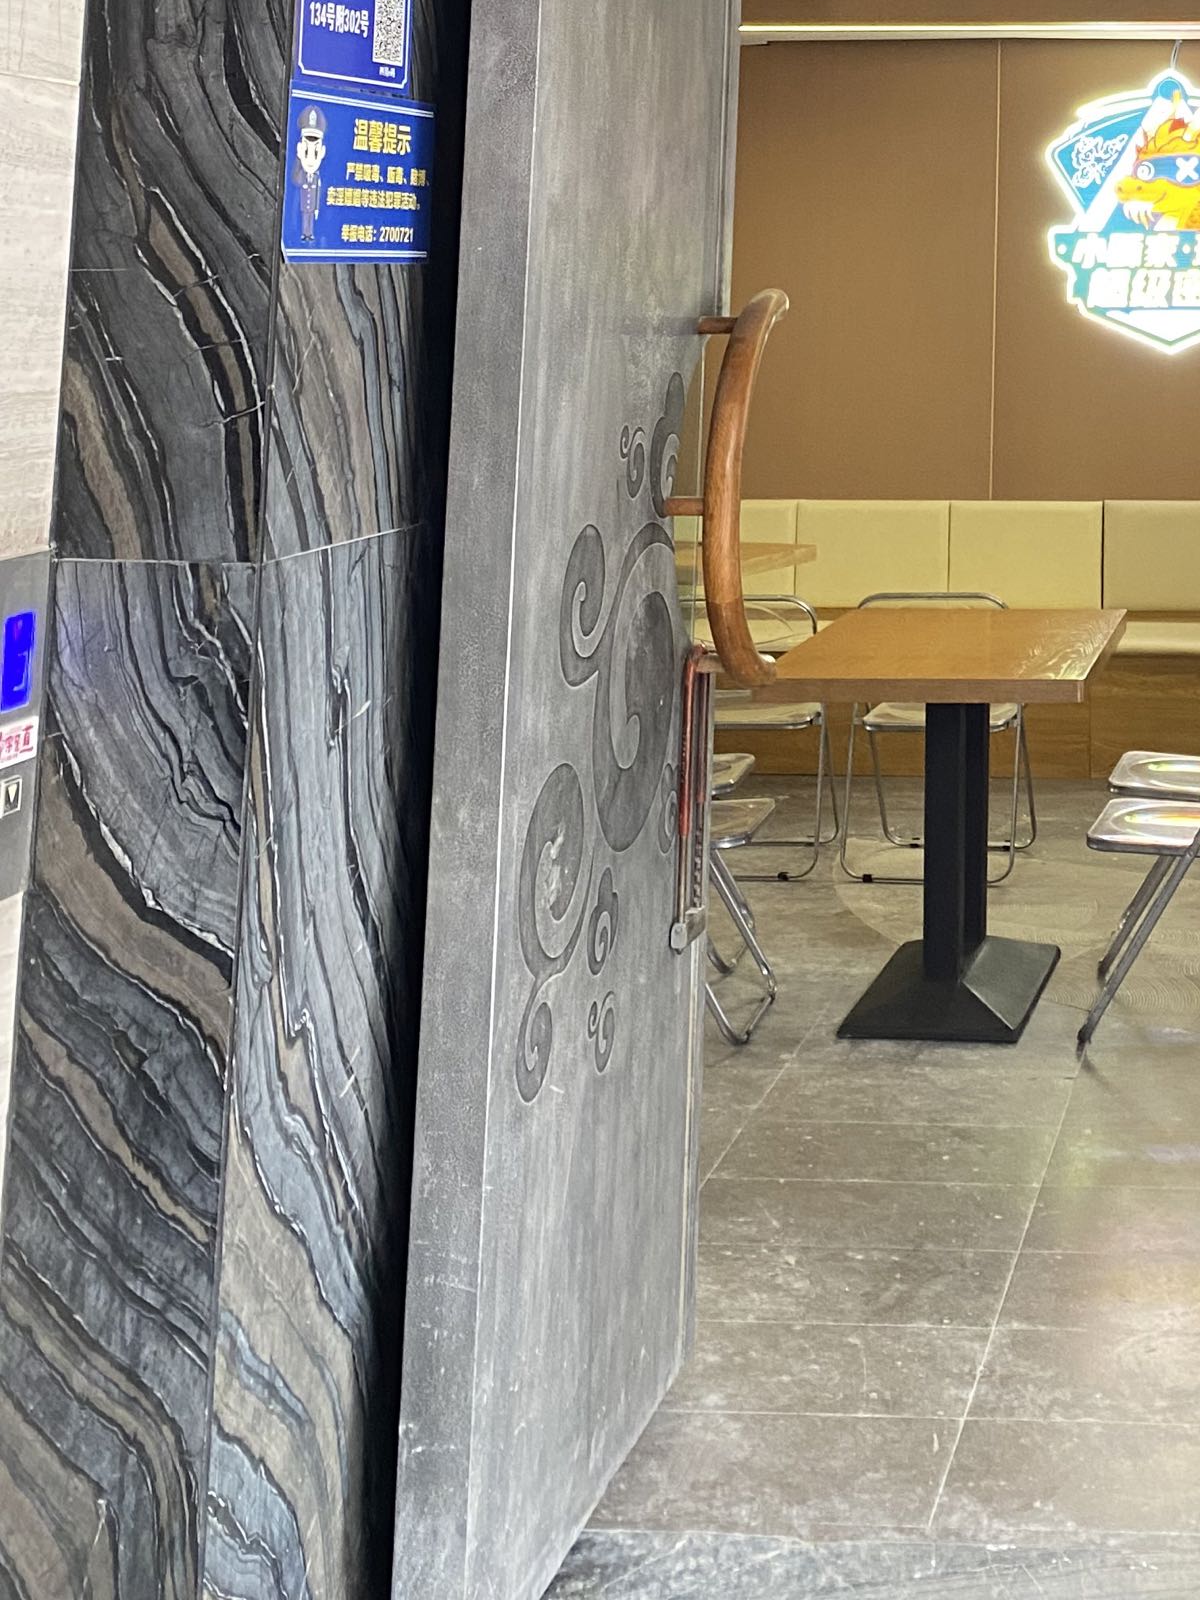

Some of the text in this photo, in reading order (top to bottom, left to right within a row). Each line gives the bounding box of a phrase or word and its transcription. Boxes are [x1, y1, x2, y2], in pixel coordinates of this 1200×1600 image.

[309, 1, 369, 38] 134号附302号
[352, 117, 412, 155] 温馨提示
